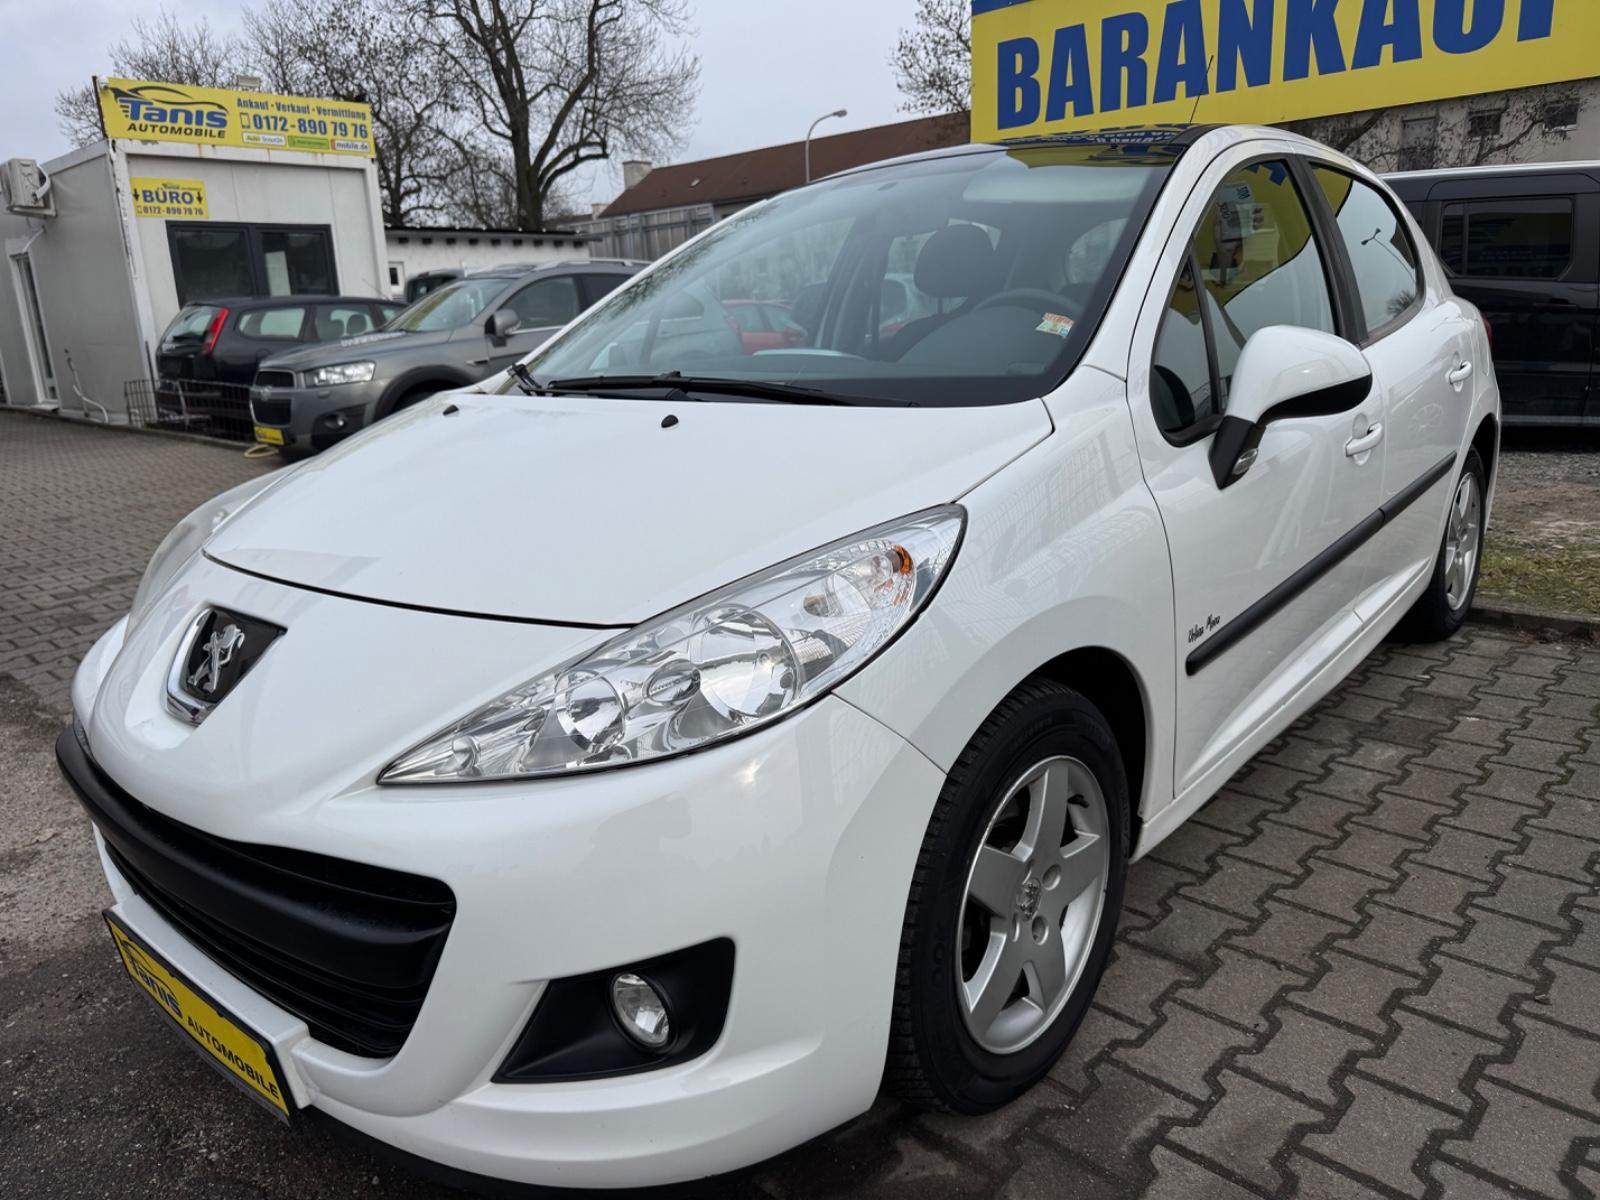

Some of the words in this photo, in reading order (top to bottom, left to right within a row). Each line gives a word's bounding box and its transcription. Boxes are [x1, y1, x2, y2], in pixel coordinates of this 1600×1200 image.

[118, 98, 228, 128] Tanis
[237, 97, 269, 110] Ankauf
[275, 101, 310, 114] Verkauf
[316, 105, 367, 120] Vermittlung
[127, 123, 226, 139] AUTOMOBILE
[330, 121, 348, 137] 79
[351, 123, 368, 139] 76
[142, 187, 194, 205] BÜRO
[187, 1015, 281, 1100] AUTOMOBILE
